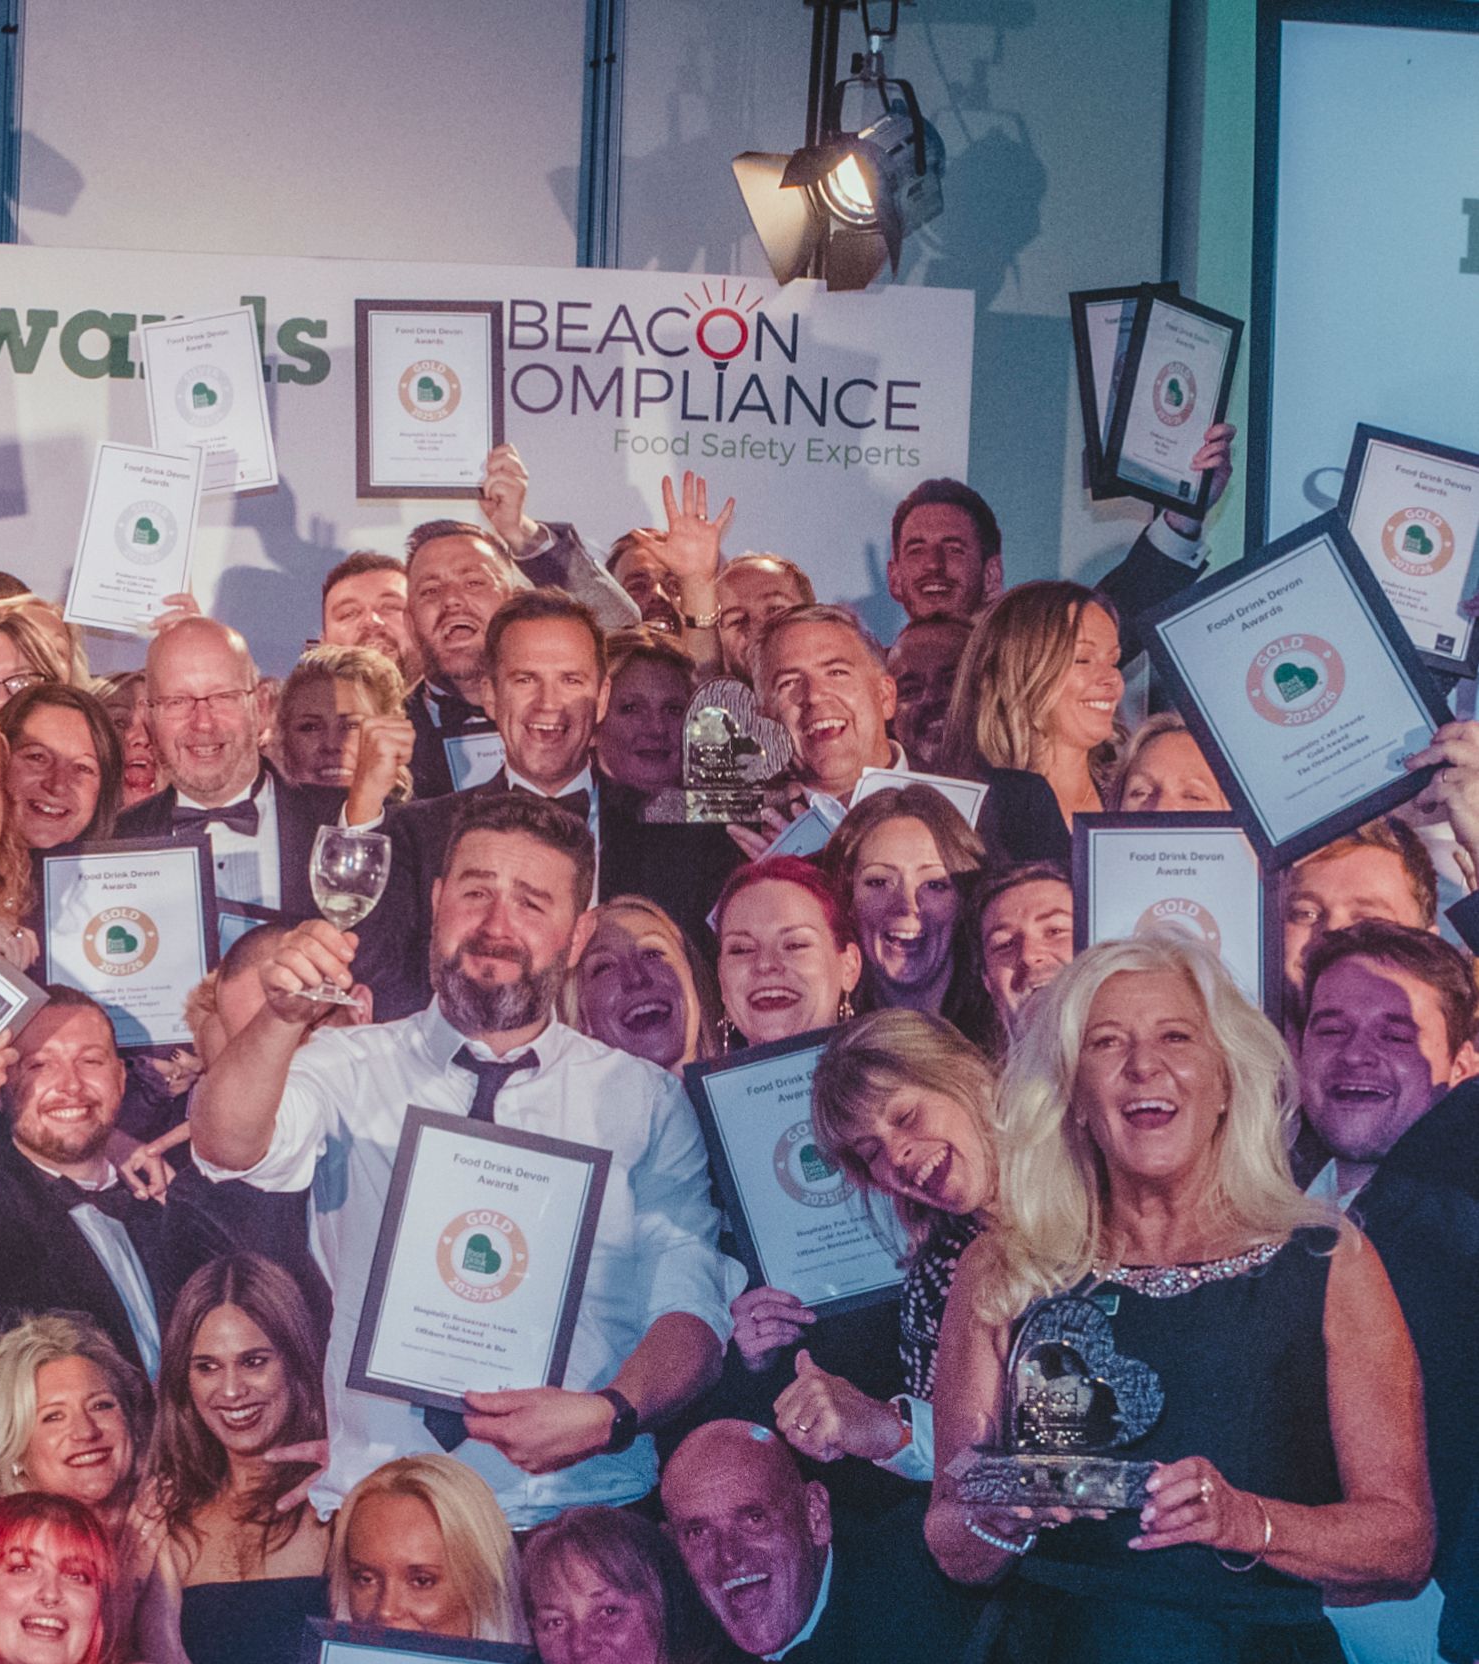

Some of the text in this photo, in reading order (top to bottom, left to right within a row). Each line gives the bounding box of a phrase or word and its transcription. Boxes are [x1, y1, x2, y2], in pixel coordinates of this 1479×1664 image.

[508, 299, 799, 364] BEACON
[510, 362, 922, 432] OMPLIANCE
[614, 430, 921, 470] Food Safety Experts
[1206, 576, 1303, 634] Food Drink Devon
[1240, 604, 1284, 632] Awards
[1258, 635, 1303, 666] GOLD
[1284, 690, 1338, 724] 2025/26
[452, 1152, 550, 1184] Food Drink Devon
[476, 1174, 520, 1192] Awards
[467, 1213, 514, 1232] GOLD
[449, 1278, 502, 1300] 2025/26
